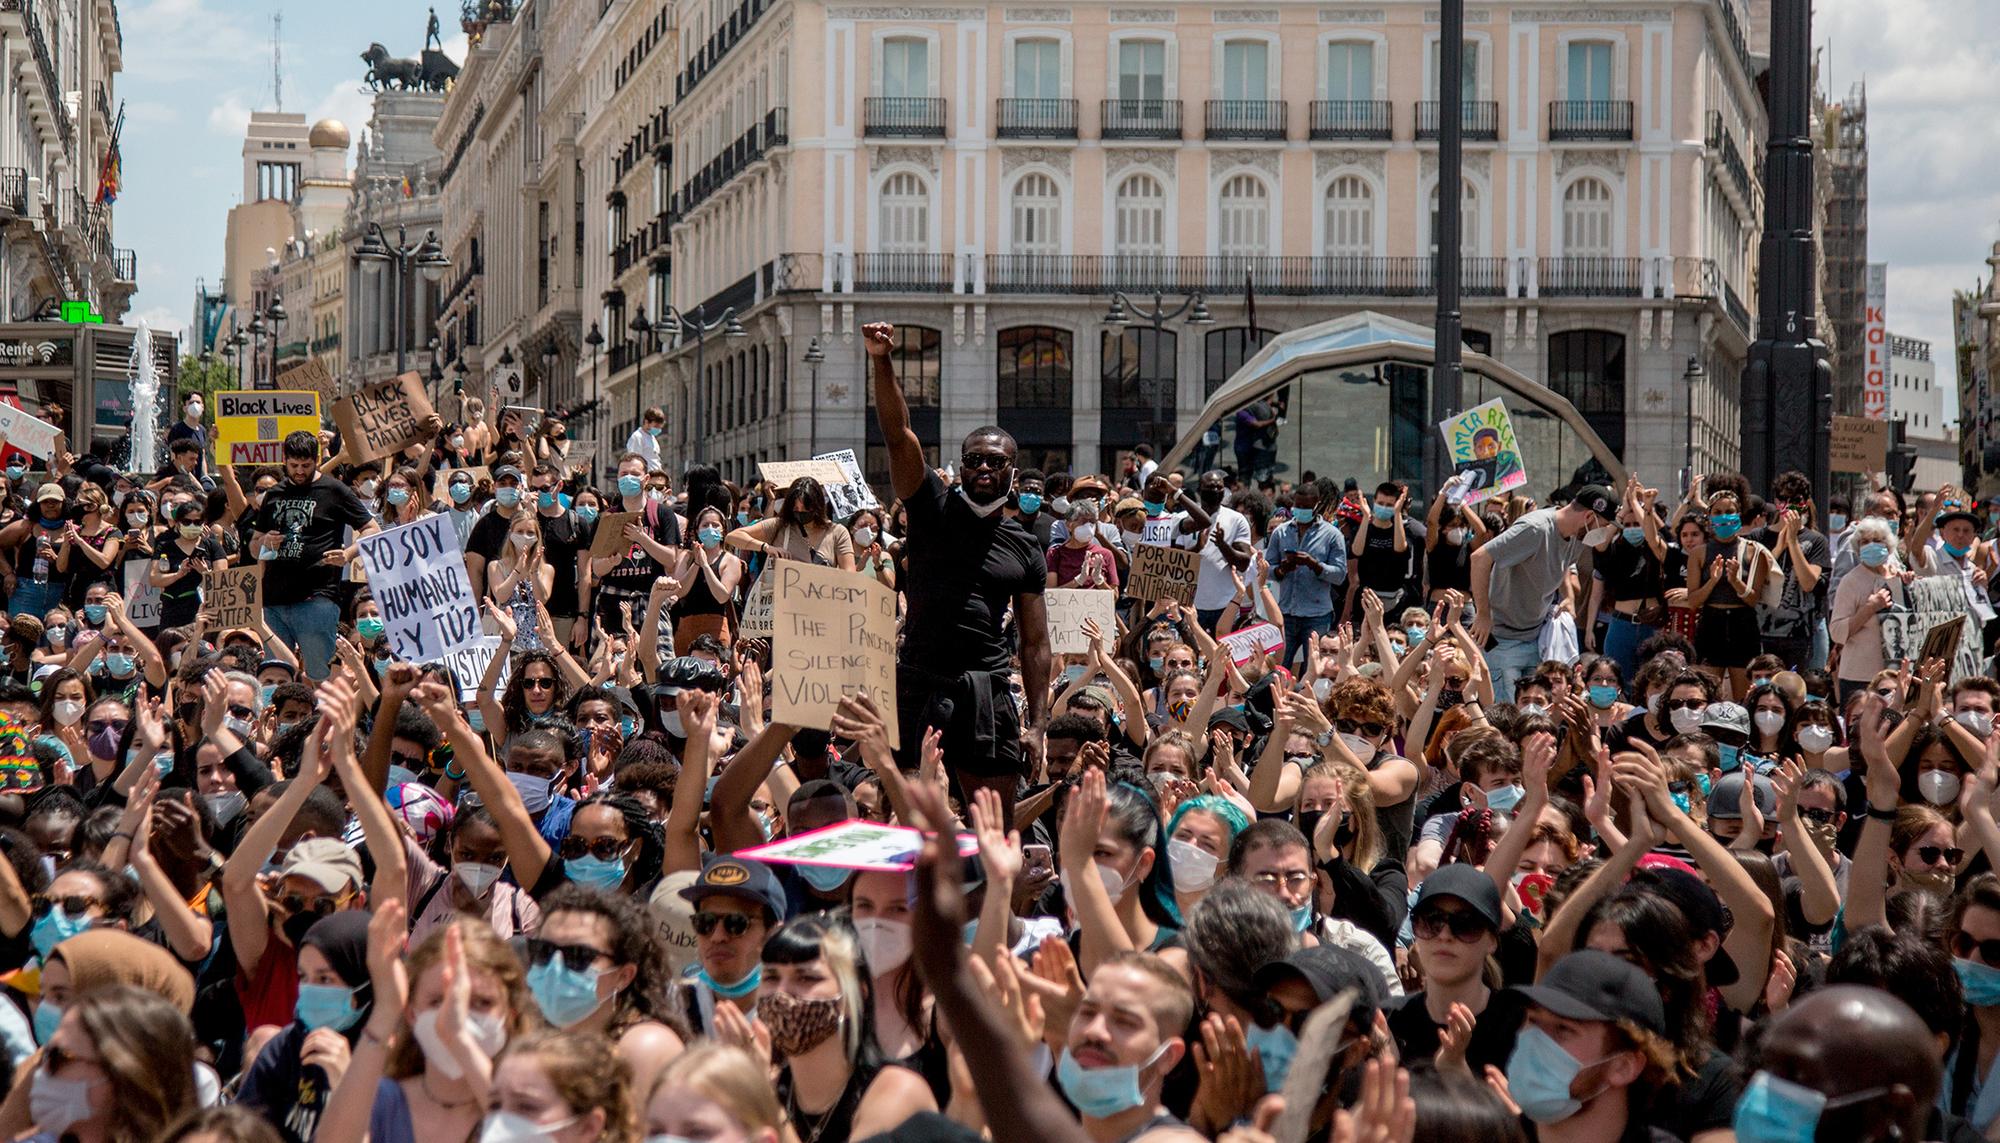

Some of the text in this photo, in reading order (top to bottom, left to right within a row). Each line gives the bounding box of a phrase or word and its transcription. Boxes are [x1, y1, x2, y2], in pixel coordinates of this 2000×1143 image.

[221, 397, 313, 416] Black Lives
[351, 381, 408, 417] BLACK
[359, 402, 412, 434] LIVES
[366, 417, 424, 451] MATTER
[231, 442, 288, 464] MATT
[272, 498, 318, 527] SPEEDER
[361, 536, 395, 573] YO
[400, 519, 444, 567] SOY
[1136, 544, 1192, 569] POR UN
[205, 571, 240, 592] BLACK
[1142, 561, 1195, 584] MUNDO
[205, 589, 237, 609] LIVES
[379, 566, 467, 622] HUMANO.
[783, 567, 868, 608] RACISM
[880, 595, 892, 617] IS
[1045, 591, 1110, 609] BLACK
[207, 607, 253, 628] ATTER
[783, 610, 828, 638] THE
[395, 603, 476, 662] ¿Y TÚ?
[1049, 624, 1111, 648] MATT
[788, 649, 872, 672] SILENCE
